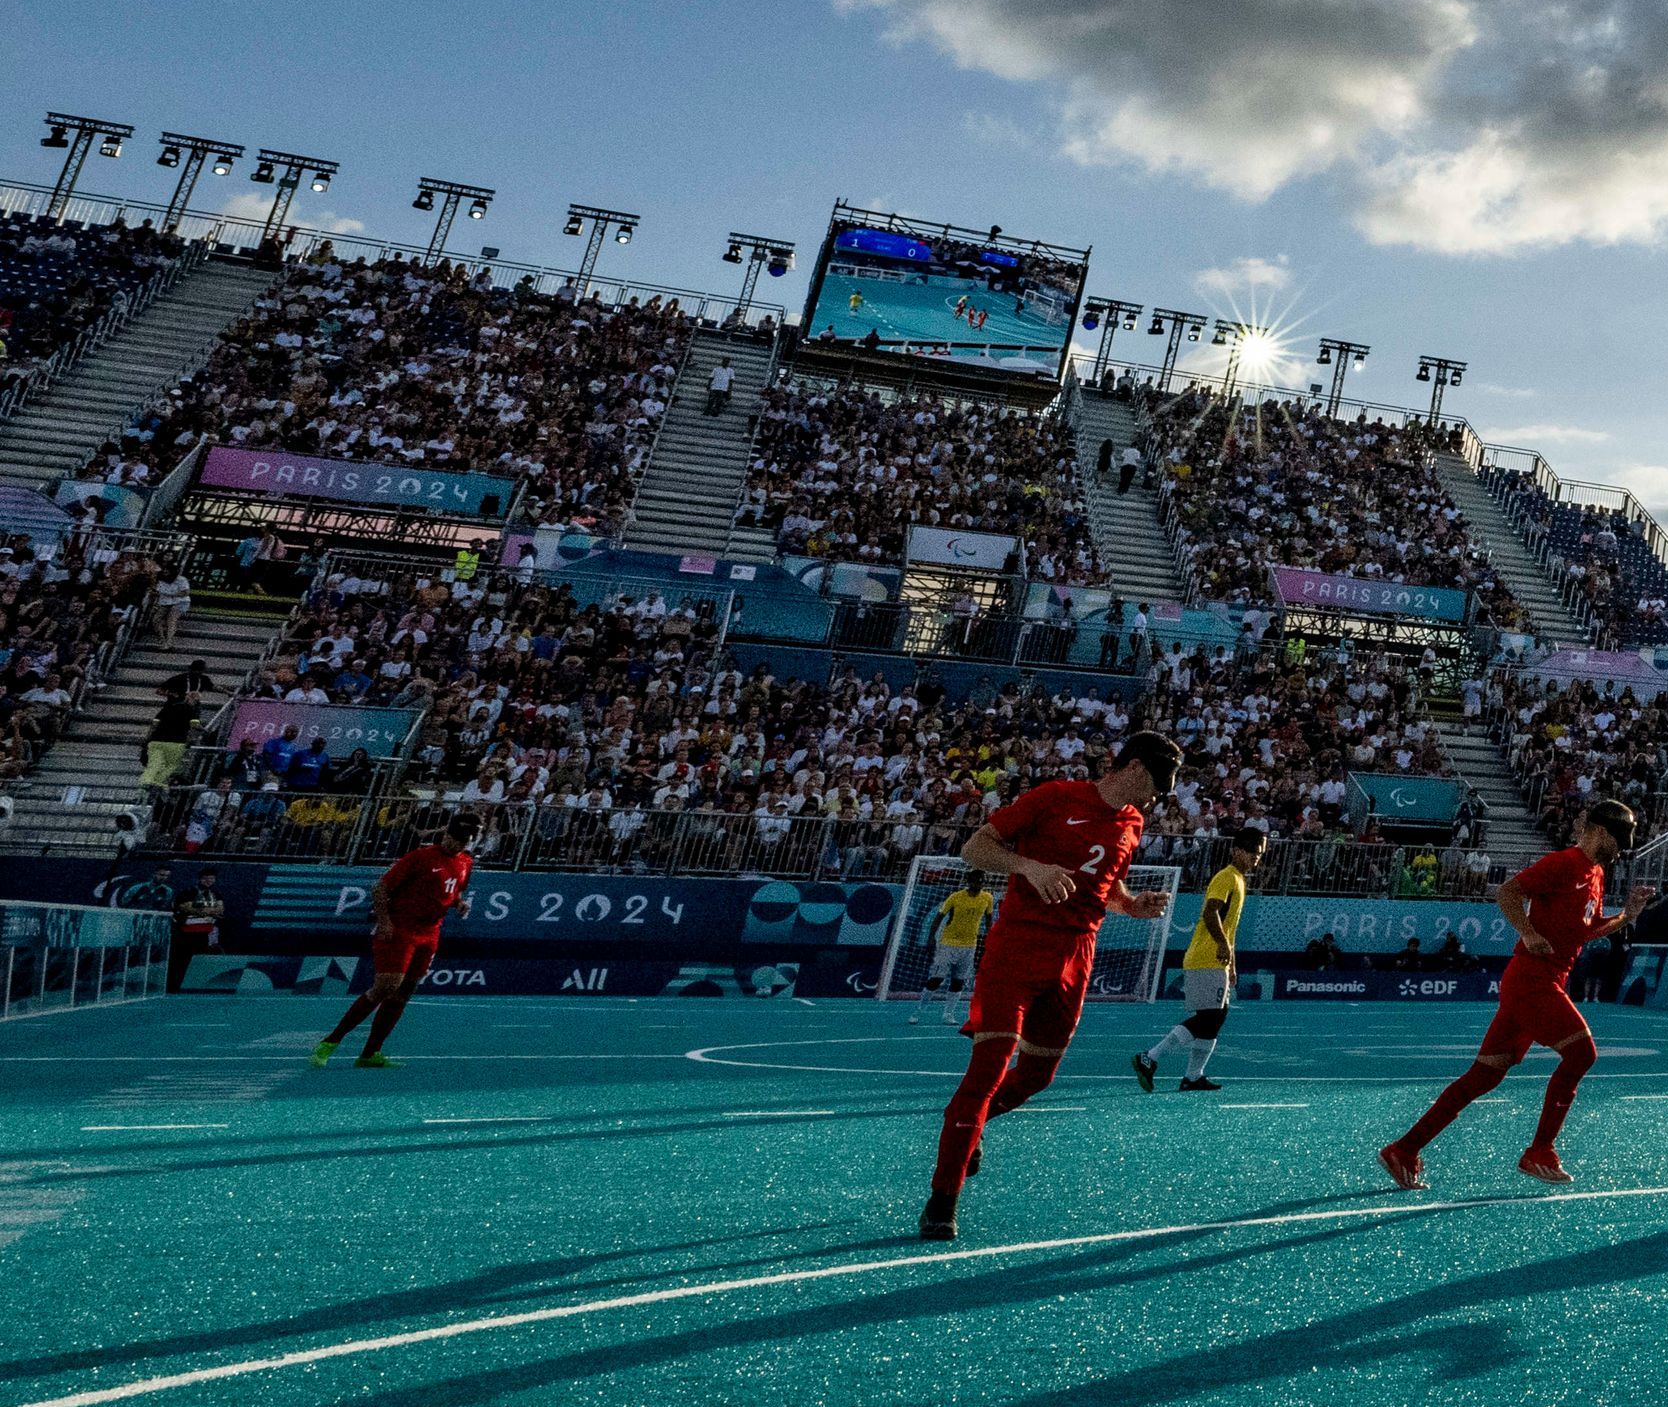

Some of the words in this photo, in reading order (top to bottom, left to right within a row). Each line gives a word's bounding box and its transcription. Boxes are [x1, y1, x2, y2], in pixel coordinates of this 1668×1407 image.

[375, 475, 469, 503] 2024
[1380, 590, 1441, 611] 2024
[1079, 844, 1106, 875] 2
[444, 878, 458, 894] 11
[535, 892, 684, 925] 2024
[1434, 916, 1507, 942] 202
[1286, 978, 1367, 994] Panasonic
